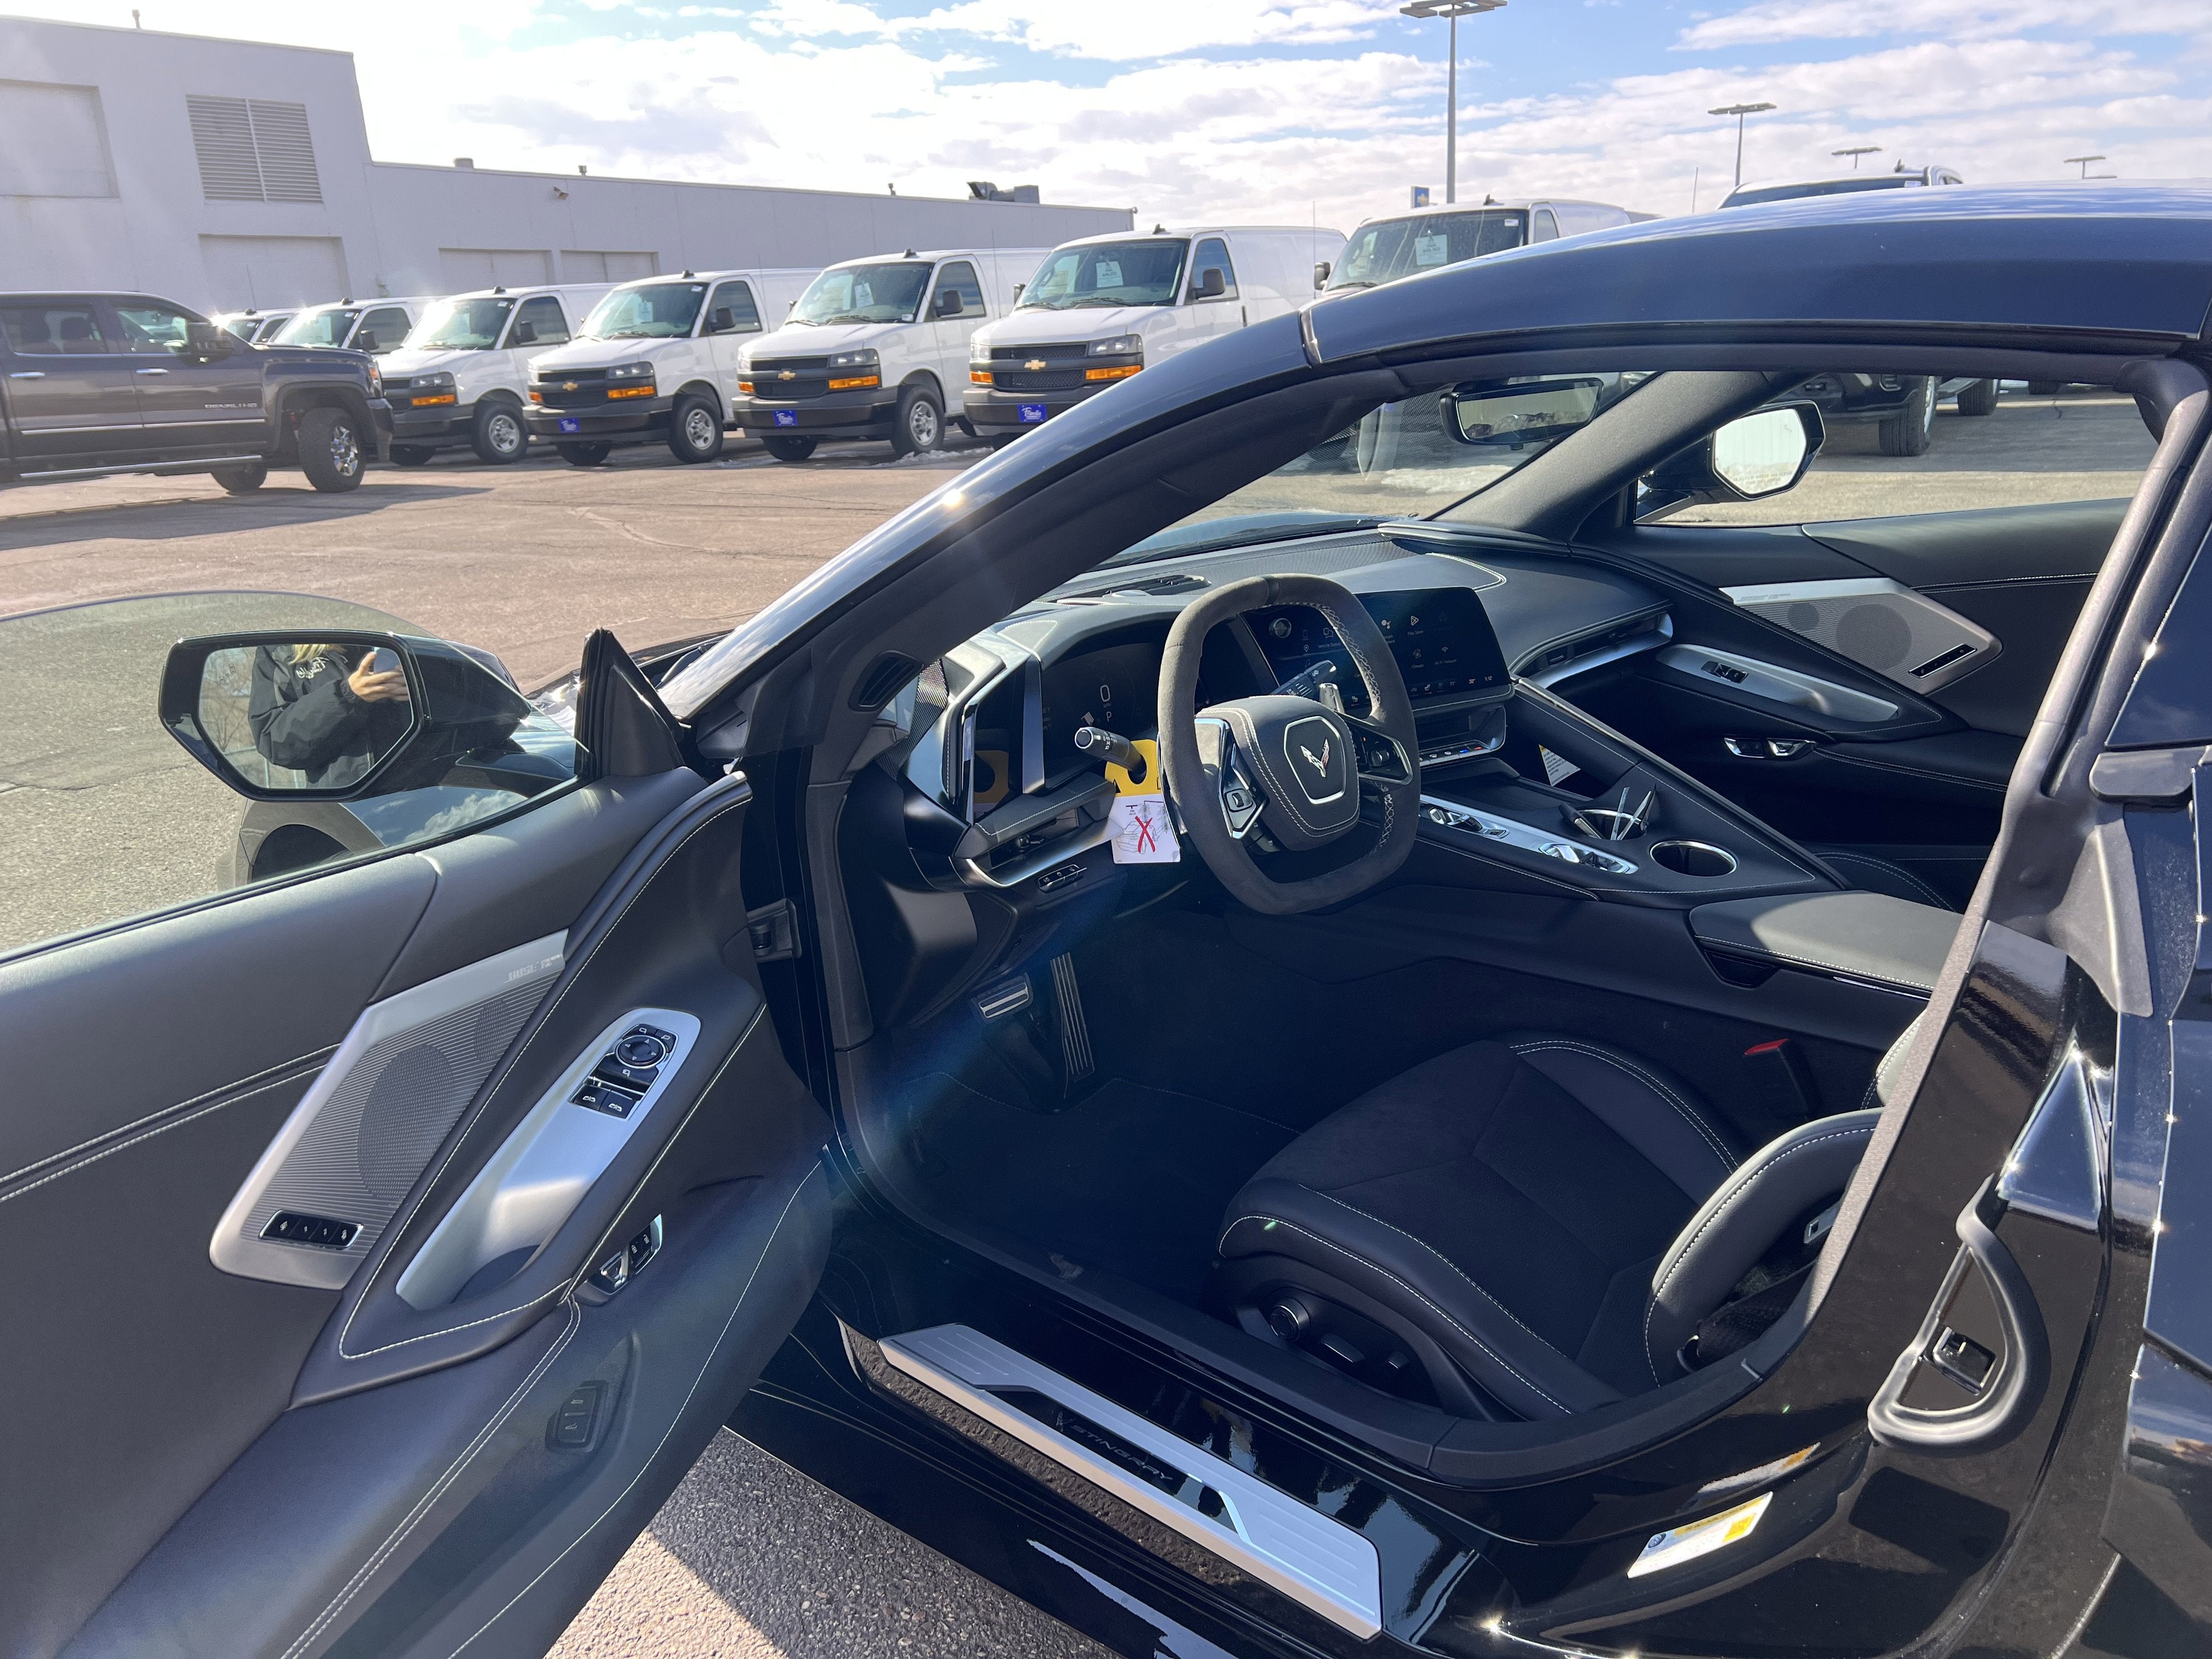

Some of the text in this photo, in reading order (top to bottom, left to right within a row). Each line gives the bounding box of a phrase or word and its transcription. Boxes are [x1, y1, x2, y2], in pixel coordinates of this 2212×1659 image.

[1099, 684, 1111, 703] 0
[1106, 711, 1112, 722] P
[1071, 1425, 1173, 1481] STINGRAY
